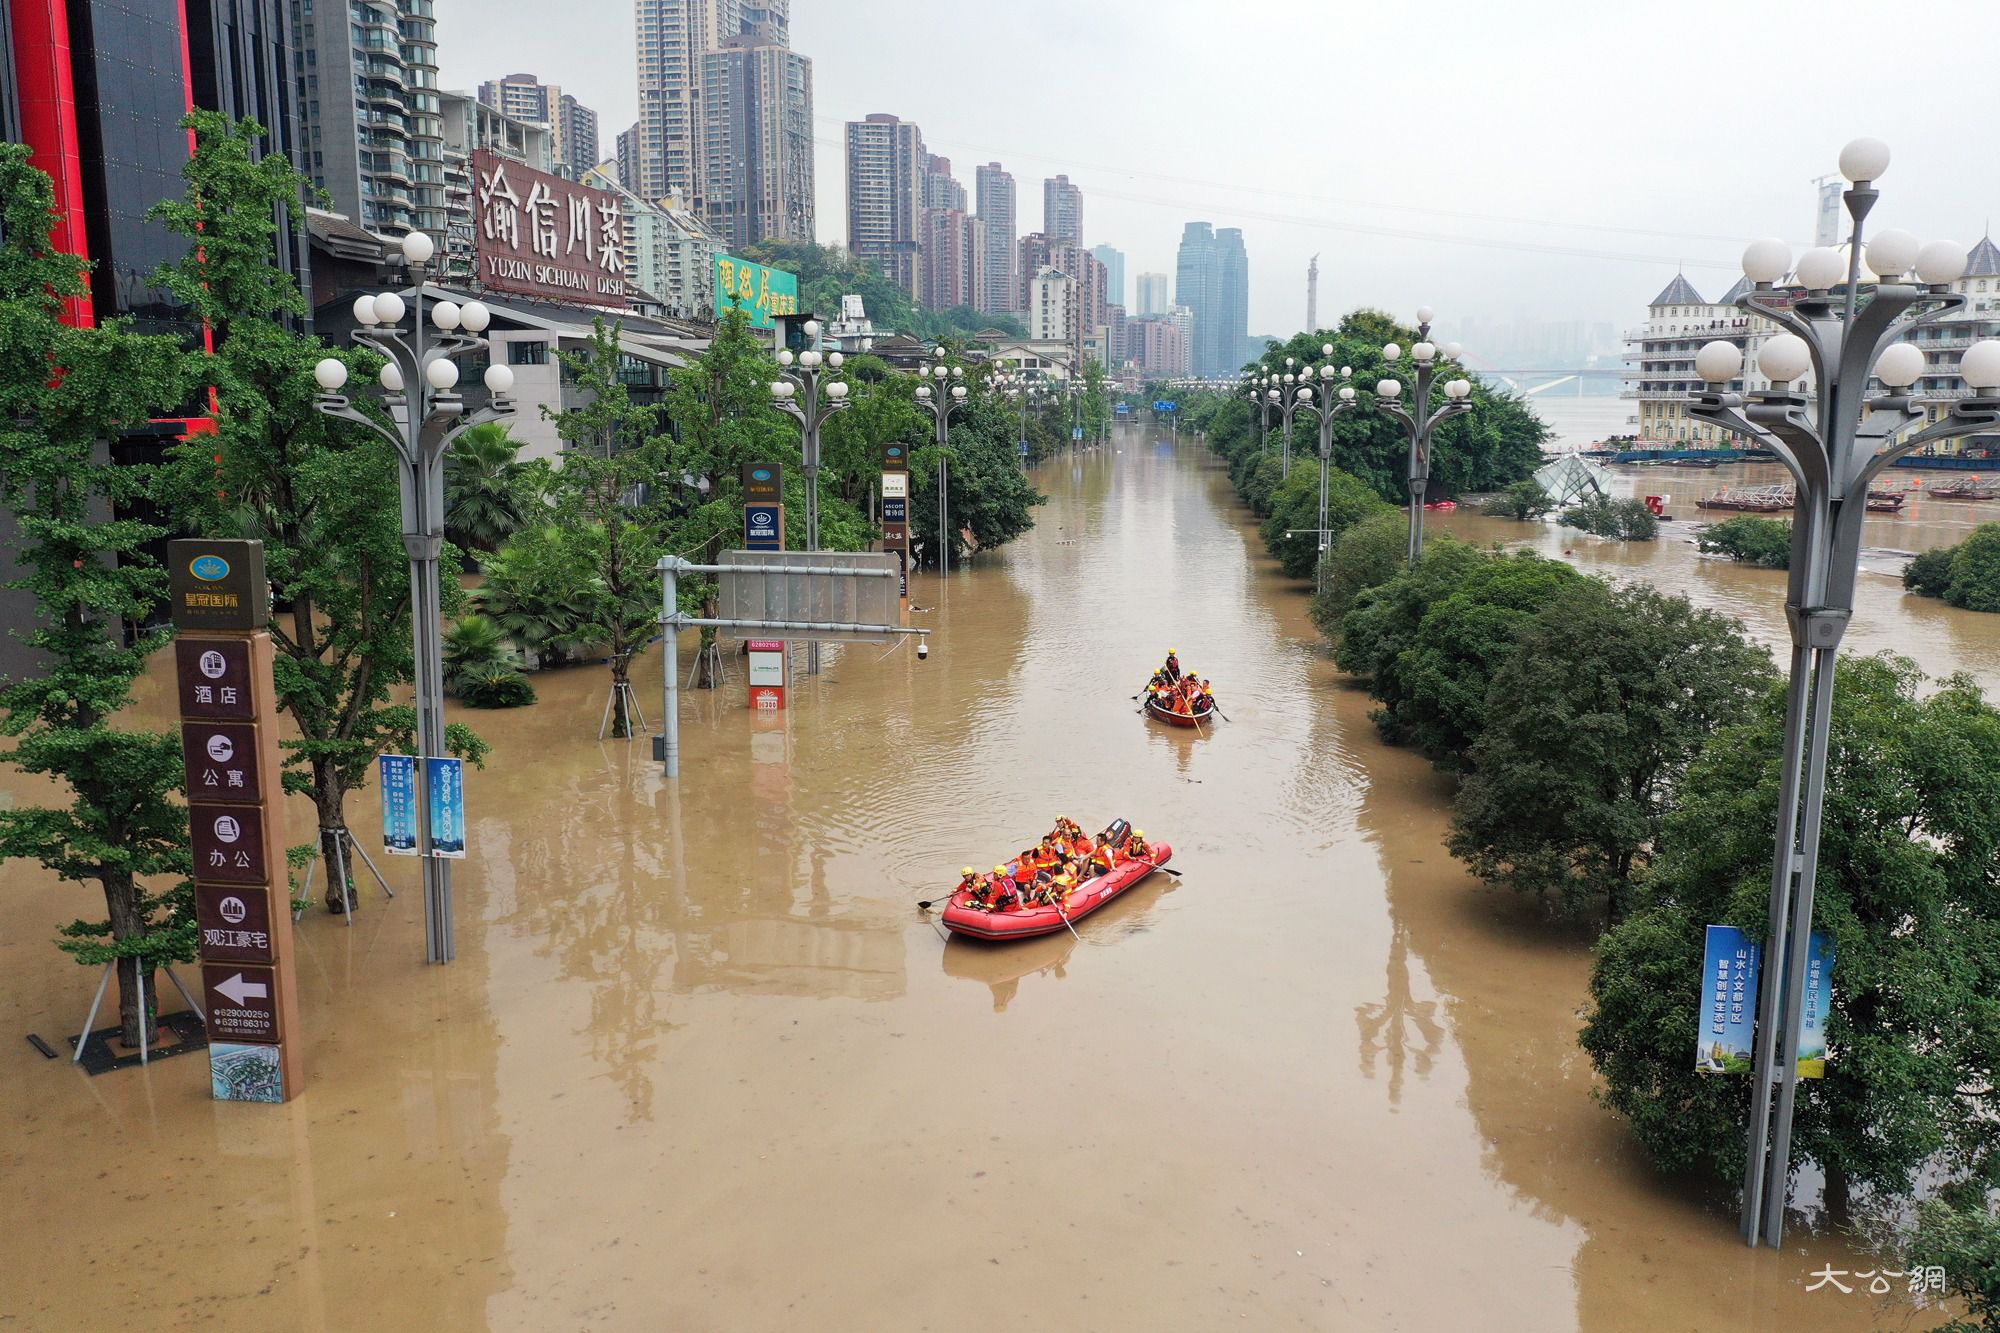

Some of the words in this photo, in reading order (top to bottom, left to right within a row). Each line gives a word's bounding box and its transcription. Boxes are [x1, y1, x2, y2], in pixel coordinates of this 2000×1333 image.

[479, 163, 625, 274] 渝信川菜
[487, 255, 531, 281] YUXIN
[535, 265, 589, 291] SICHUAN
[597, 276, 624, 296] DISH
[185, 592, 238, 607] 皇冠国际
[195, 685, 237, 705] 酒店
[202, 769, 244, 788] 公寓
[209, 849, 250, 869] 办公
[204, 929, 267, 949] 观江豪宅
[1730, 948, 1747, 1024] 山水人文都市区
[1712, 959, 1729, 1035] 智慧创新生态城
[220, 1008, 263, 1019] 62900025
